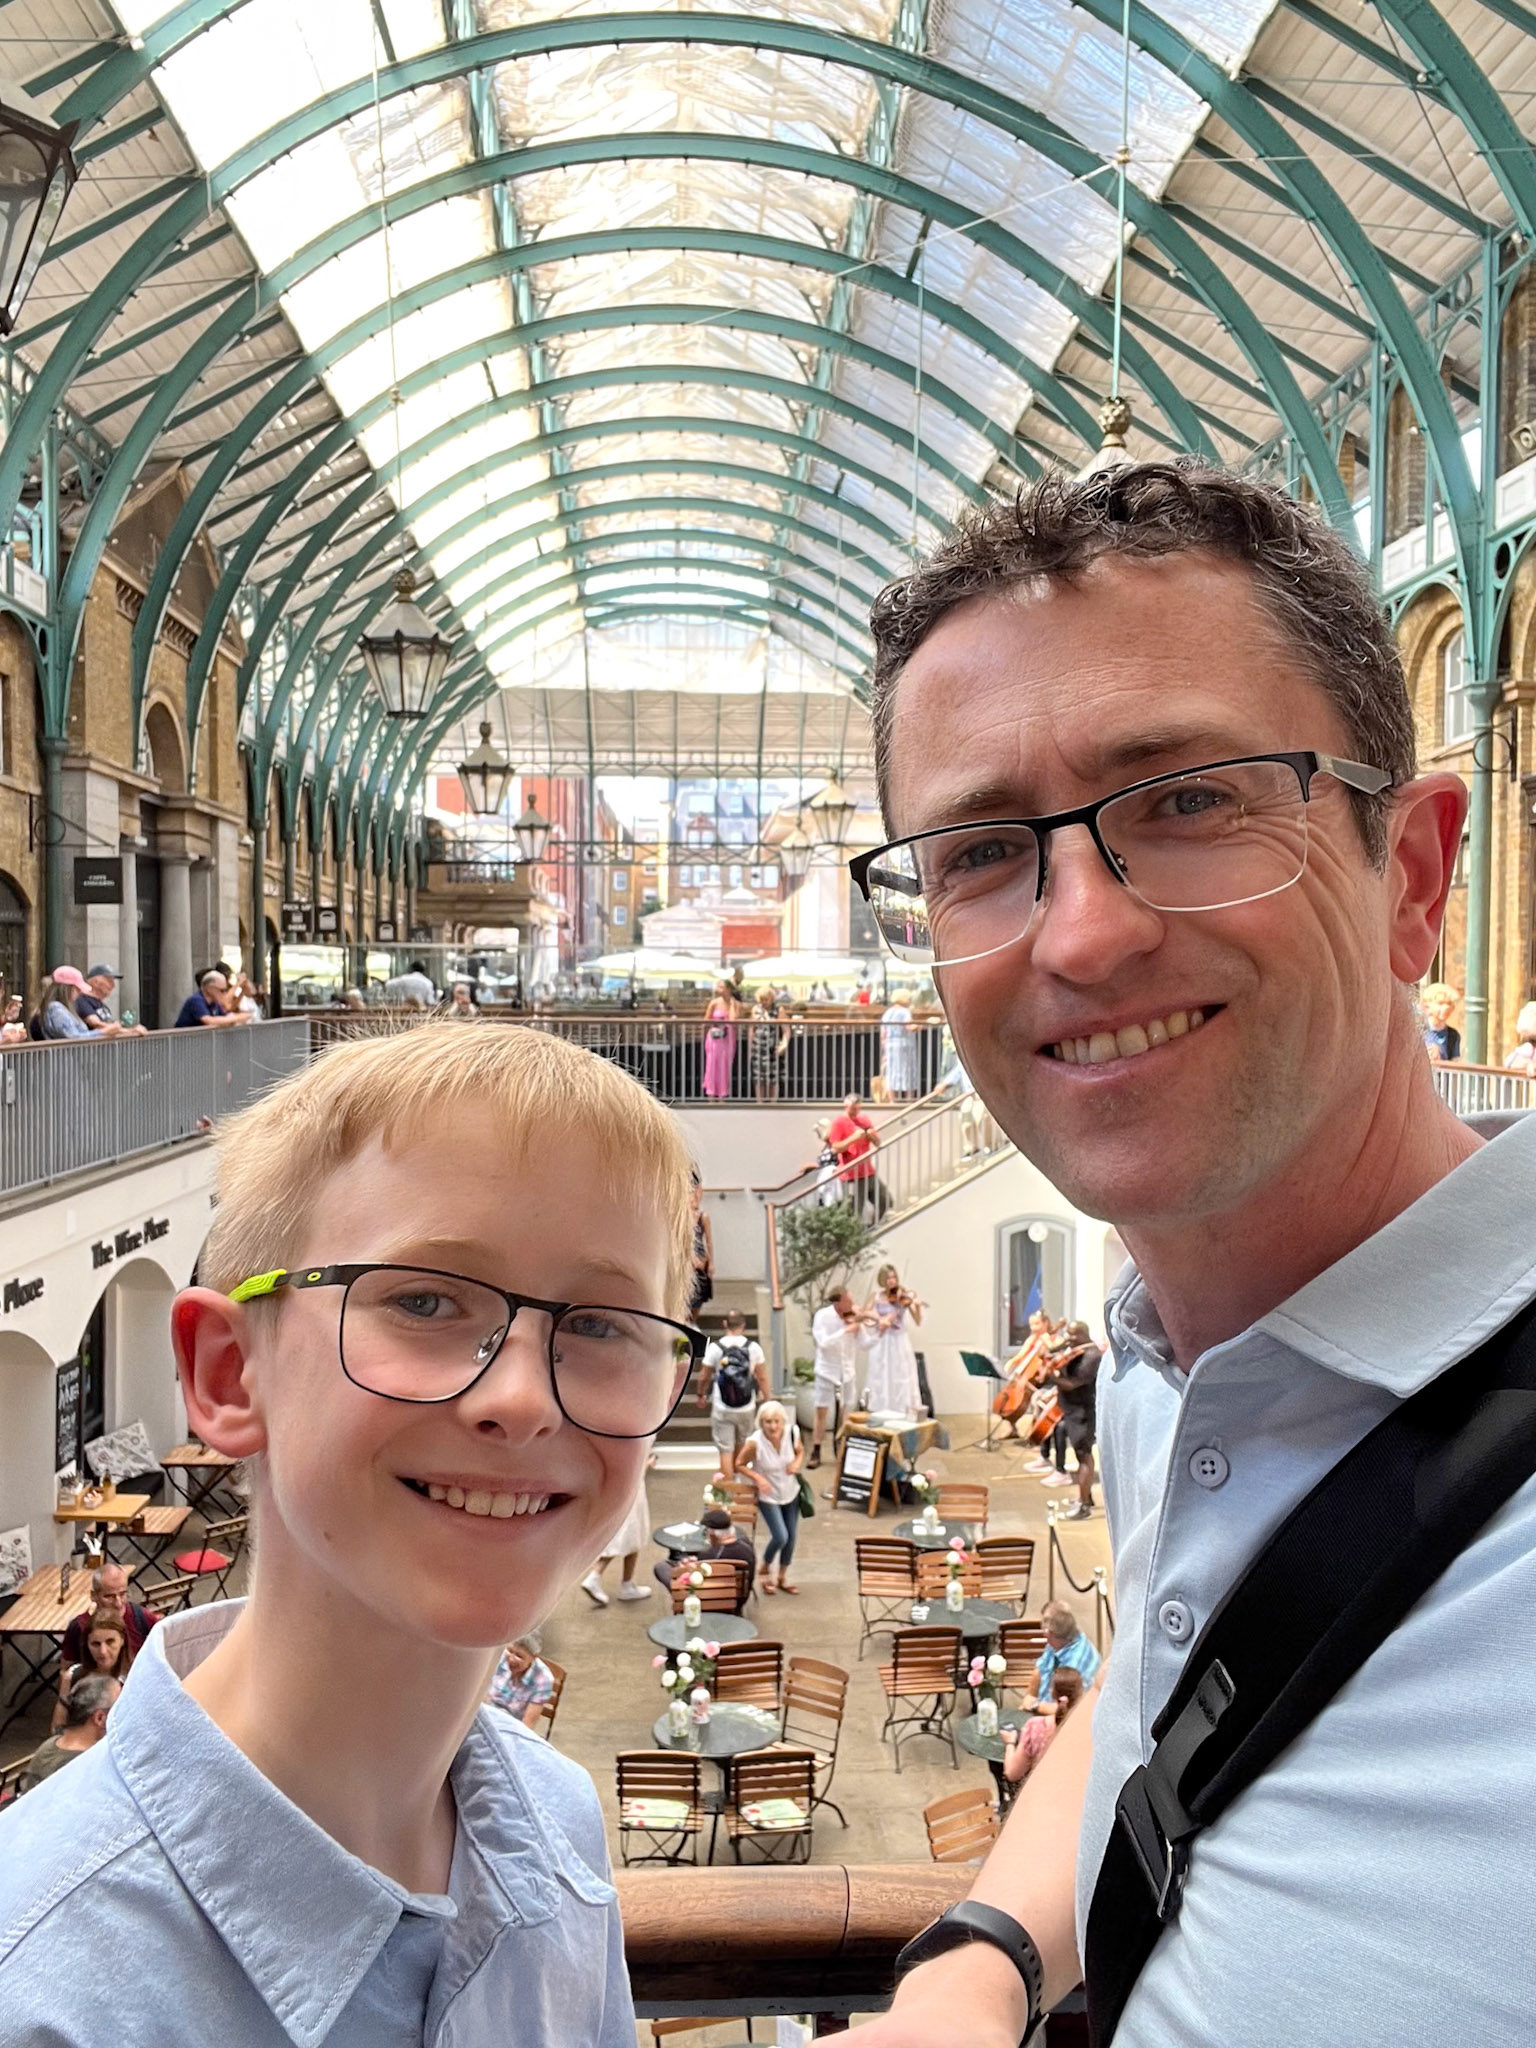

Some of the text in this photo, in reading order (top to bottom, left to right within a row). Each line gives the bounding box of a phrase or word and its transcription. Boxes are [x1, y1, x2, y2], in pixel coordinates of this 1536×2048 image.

[91, 1216, 169, 1270] The Wine Place
[4, 1277, 44, 1314] Place
